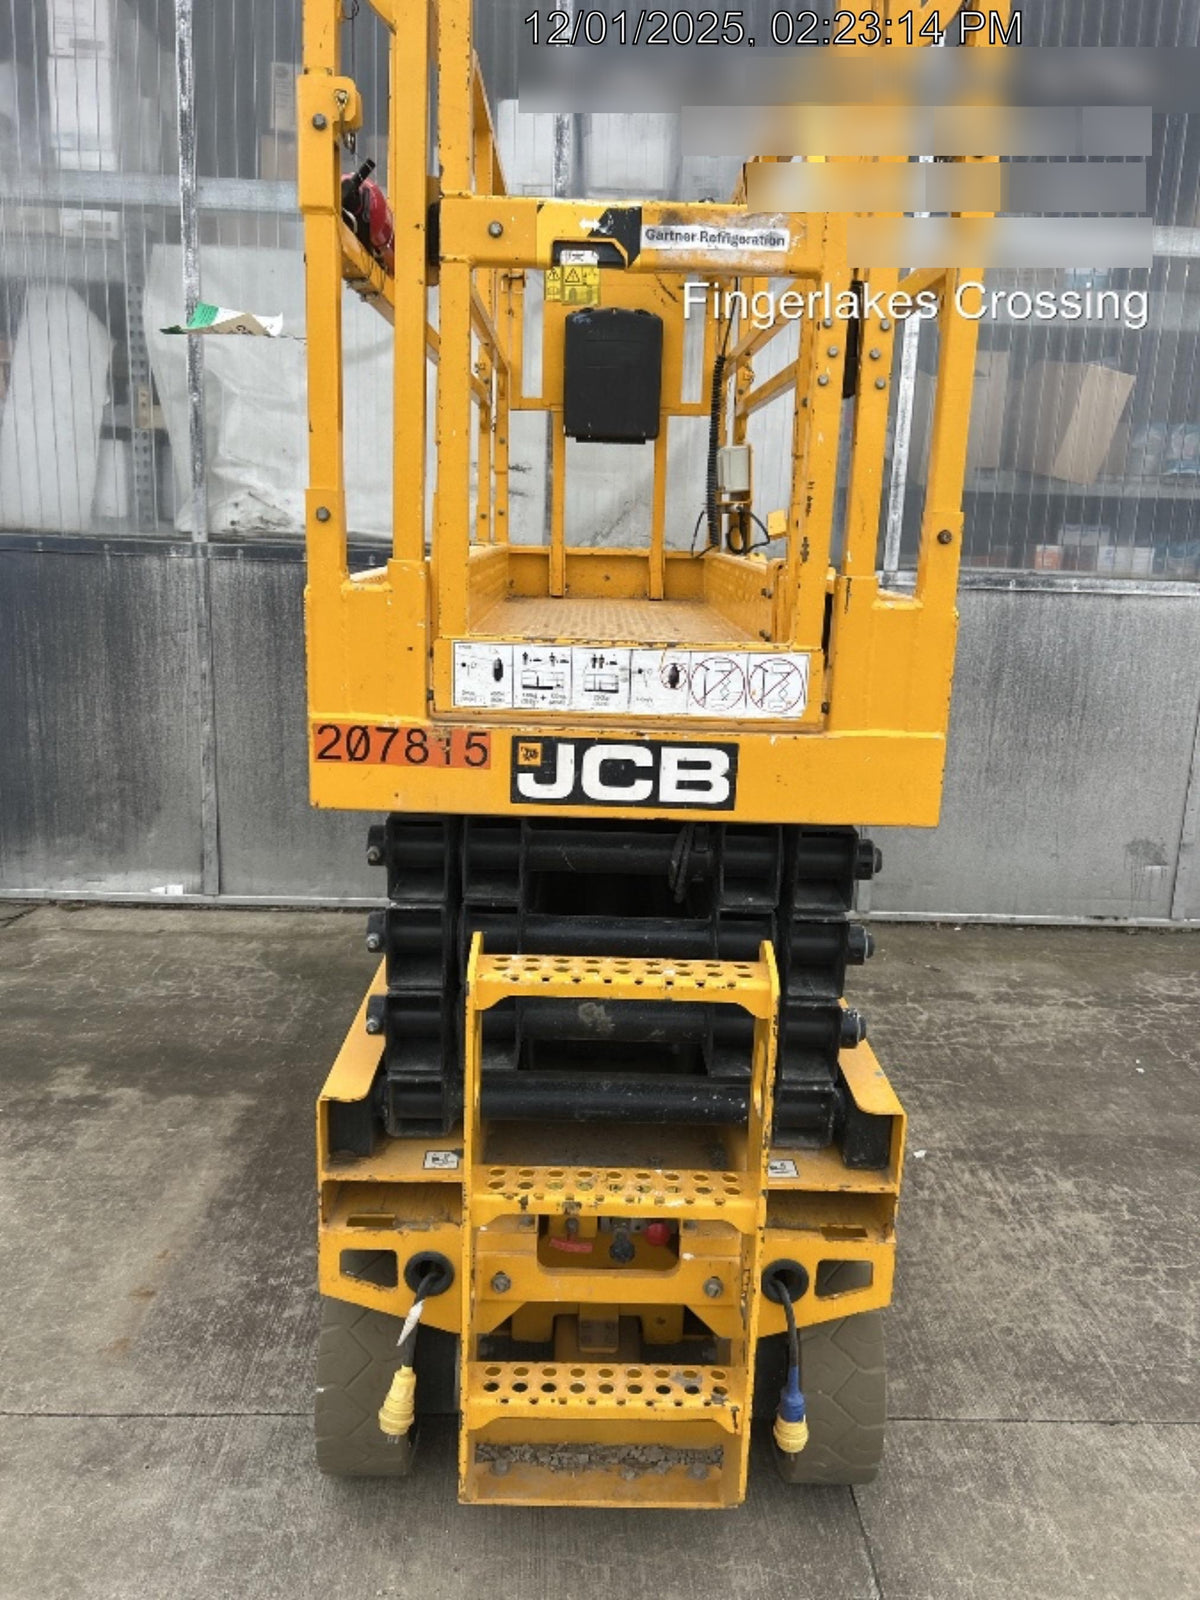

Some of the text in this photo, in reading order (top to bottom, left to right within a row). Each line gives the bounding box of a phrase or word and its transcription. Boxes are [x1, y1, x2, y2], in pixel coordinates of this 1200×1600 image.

[645, 228, 785, 247] Gartner Refrigeration
[317, 724, 489, 767] 207815
[516, 743, 731, 804] JCB
